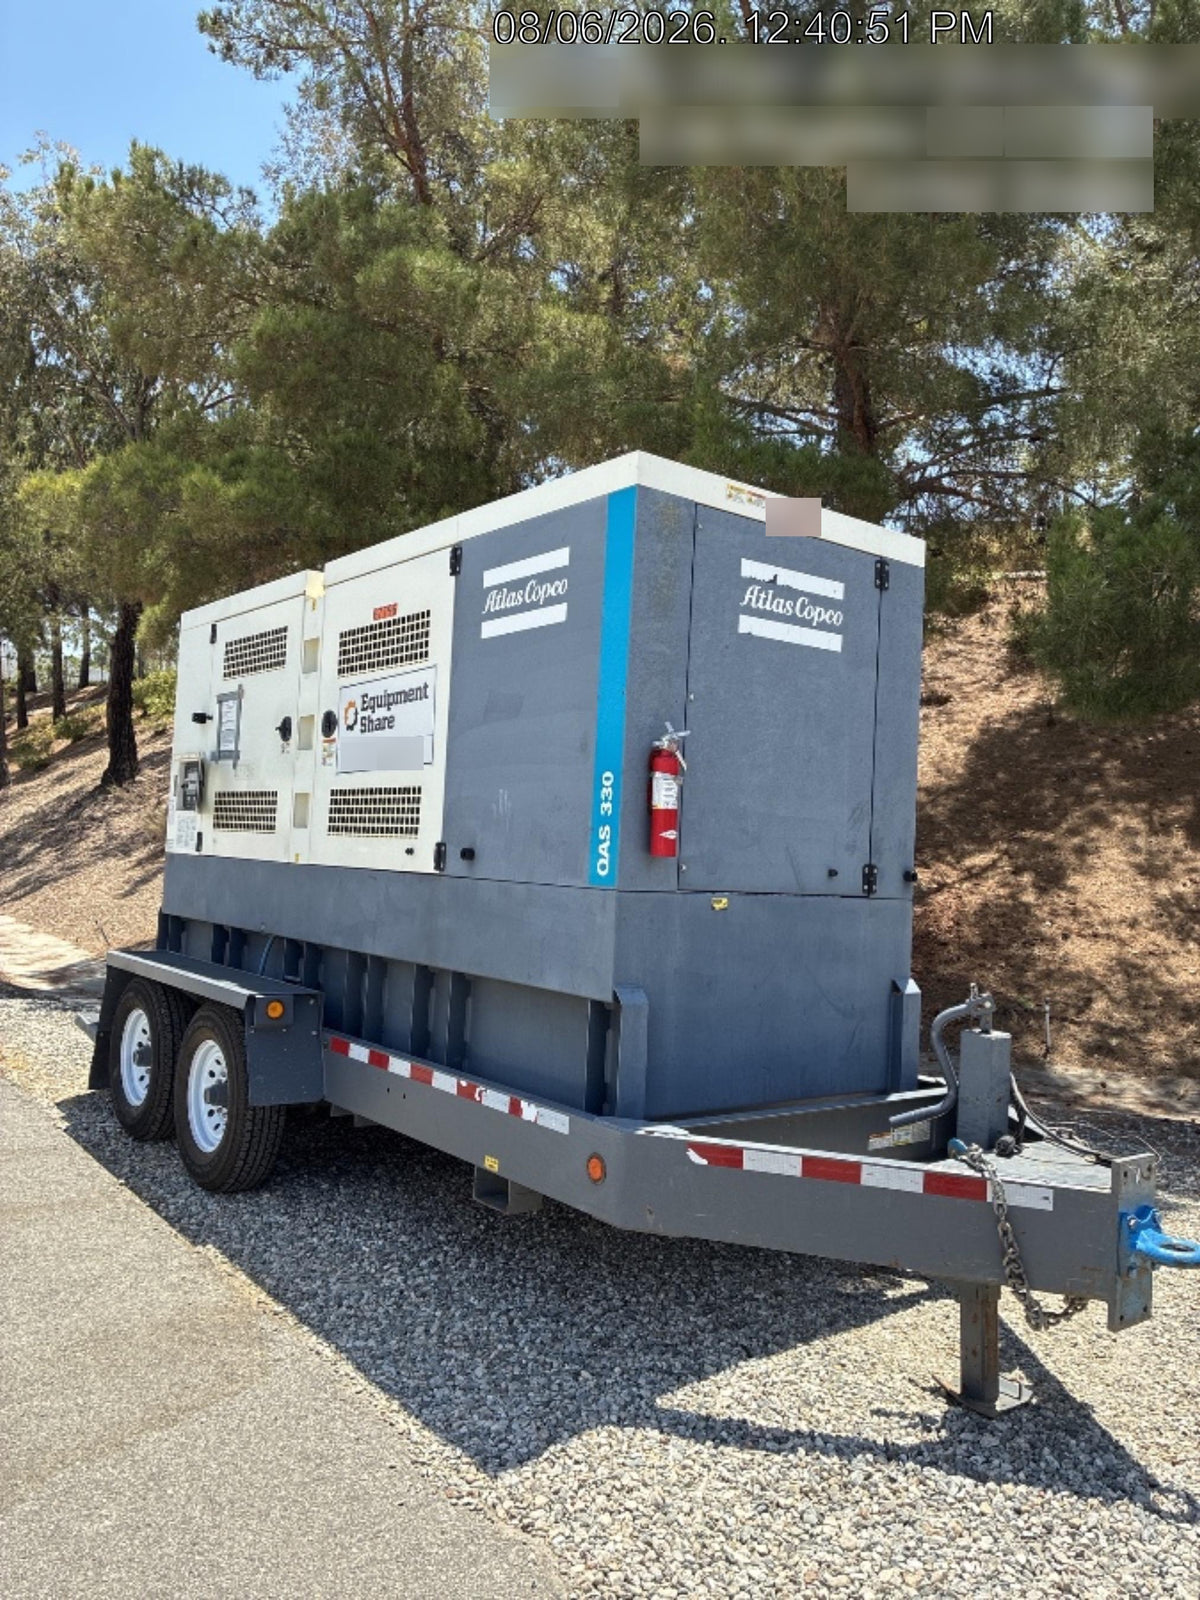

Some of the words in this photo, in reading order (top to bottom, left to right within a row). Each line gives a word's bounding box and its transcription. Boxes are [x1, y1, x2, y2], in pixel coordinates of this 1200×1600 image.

[481, 588, 523, 614] Atlas
[524, 579, 568, 605] Copco
[739, 585, 793, 616] Atlas
[795, 597, 843, 627] Copco
[361, 682, 429, 713] Equipment
[360, 715, 395, 733] Share
[600, 771, 615, 816] 330
[597, 824, 611, 876] QAS
